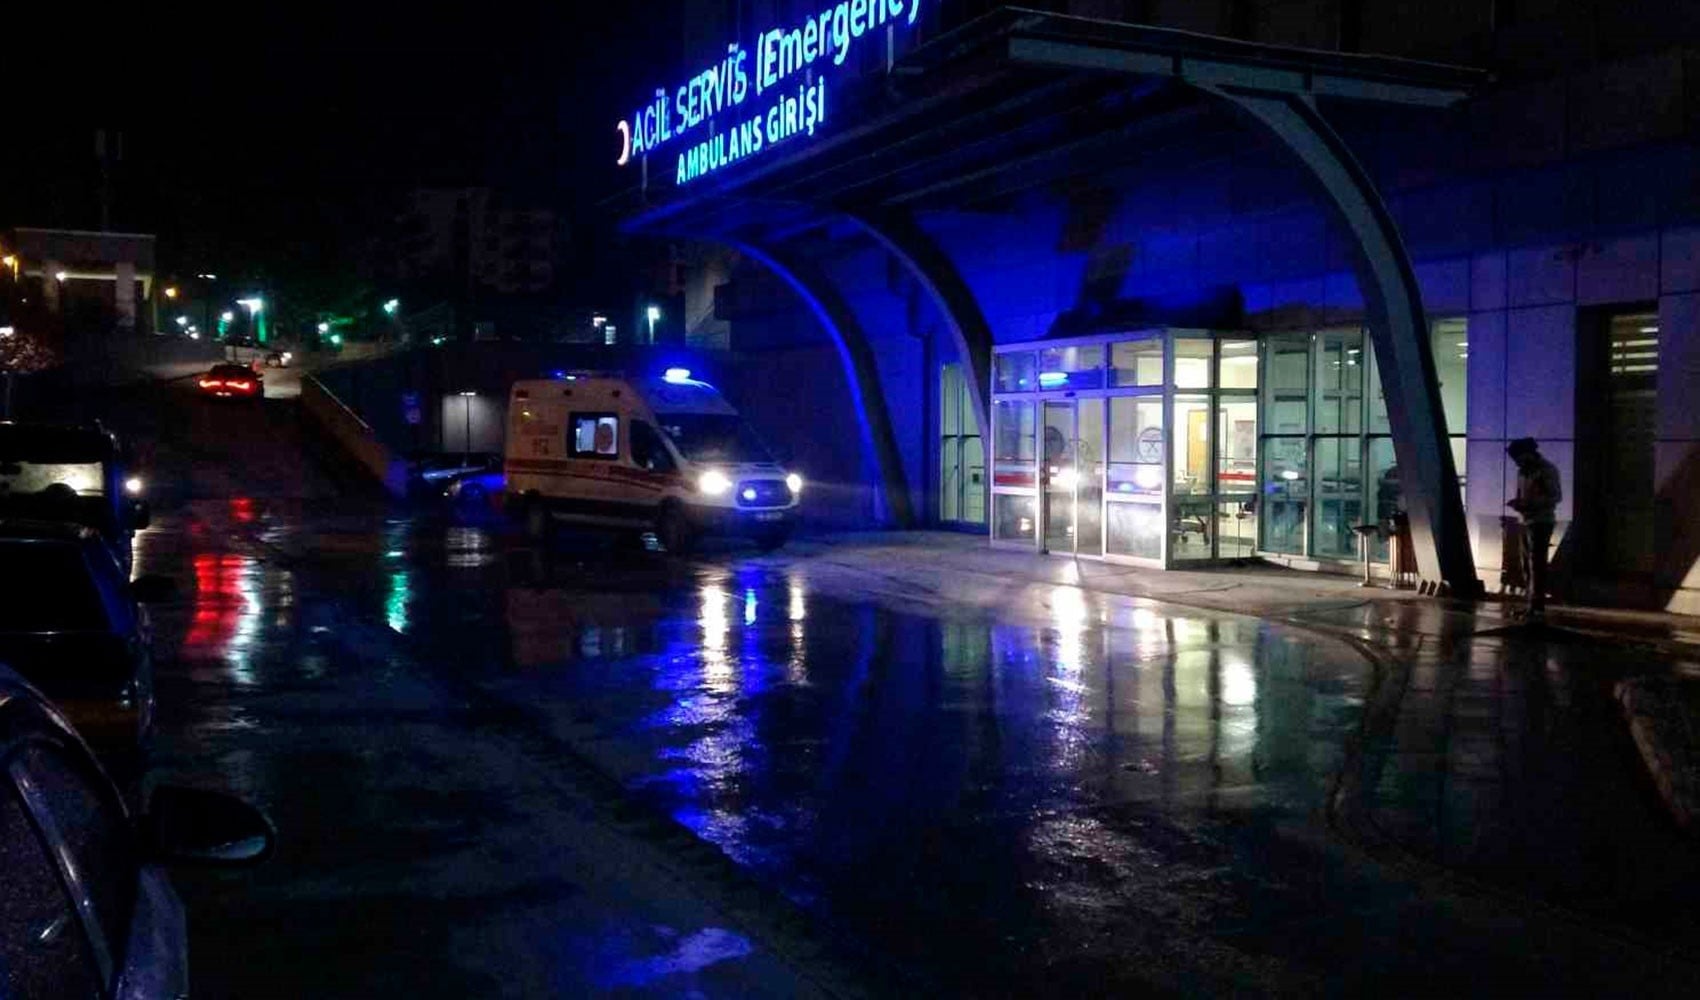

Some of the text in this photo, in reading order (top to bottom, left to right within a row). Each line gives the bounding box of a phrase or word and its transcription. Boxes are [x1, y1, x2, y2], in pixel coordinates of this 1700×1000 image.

[632, 88, 671, 156] ACİL
[675, 43, 748, 135] SERVİS
[677, 75, 824, 185] AMBULANS GİRİŞİ
